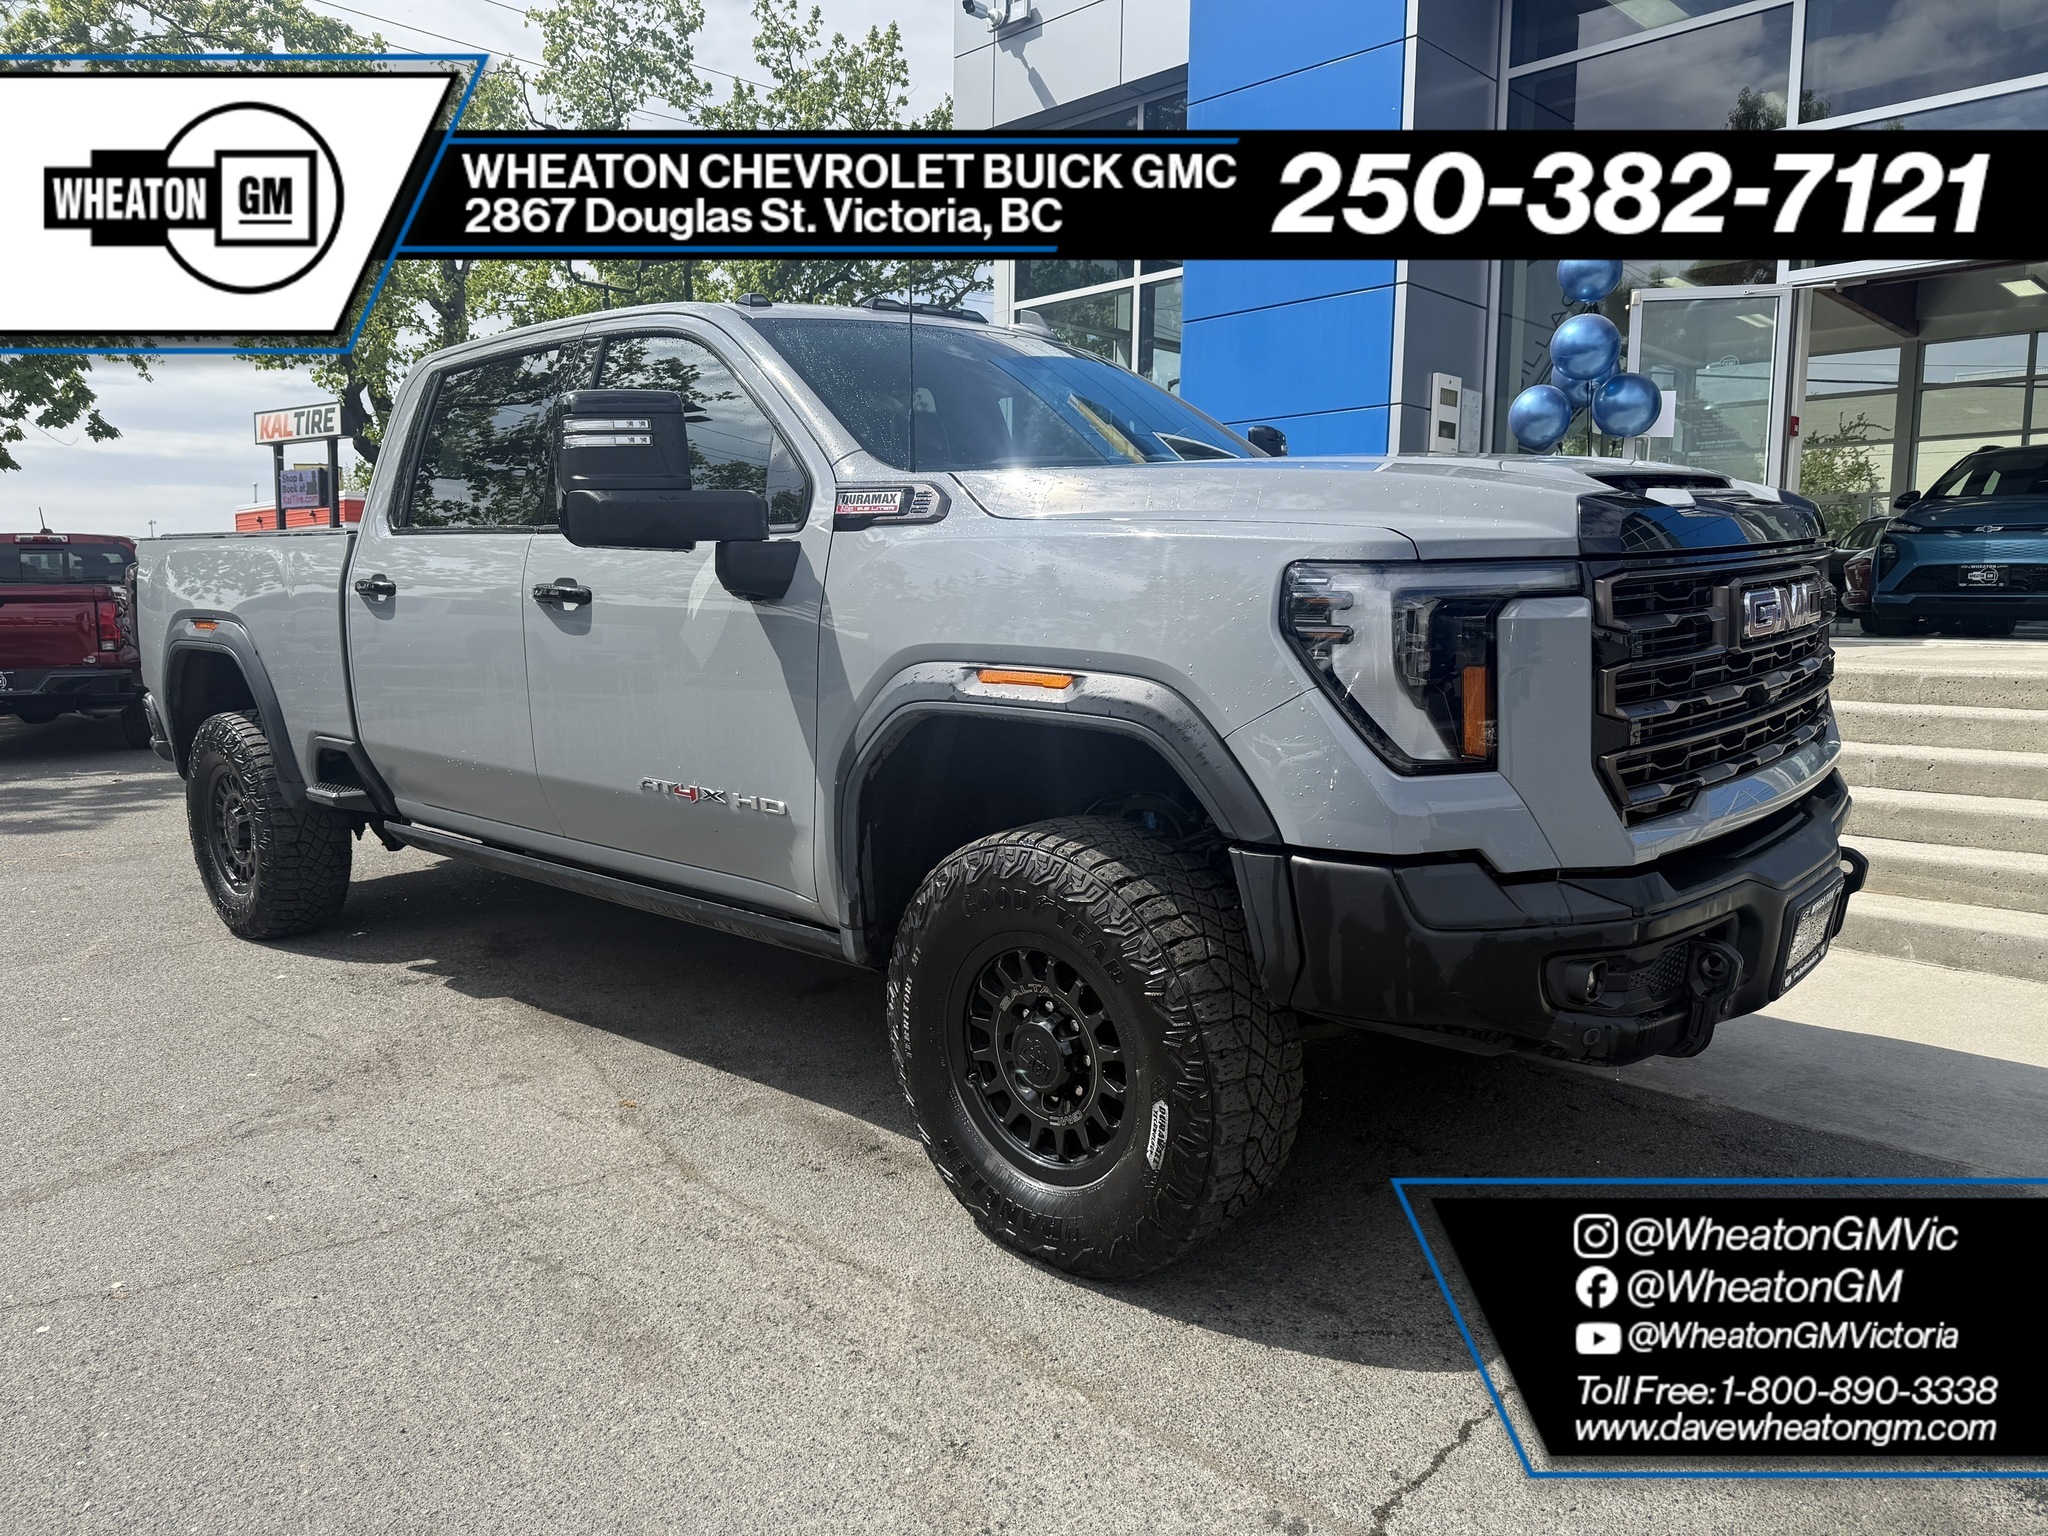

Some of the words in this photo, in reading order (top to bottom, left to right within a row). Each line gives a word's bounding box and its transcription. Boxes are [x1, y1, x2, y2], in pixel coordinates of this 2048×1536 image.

[282, 474, 297, 484] Shop
[282, 483, 298, 494] Book
[299, 484, 306, 493] at
[841, 493, 897, 505] DURAMAX
[1743, 582, 1822, 638] GMC
[638, 775, 727, 804] AT4X
[732, 792, 786, 816] HD
[902, 974, 914, 1060] TERRITORY
[1153, 1105, 1167, 1165] DURAWALL
